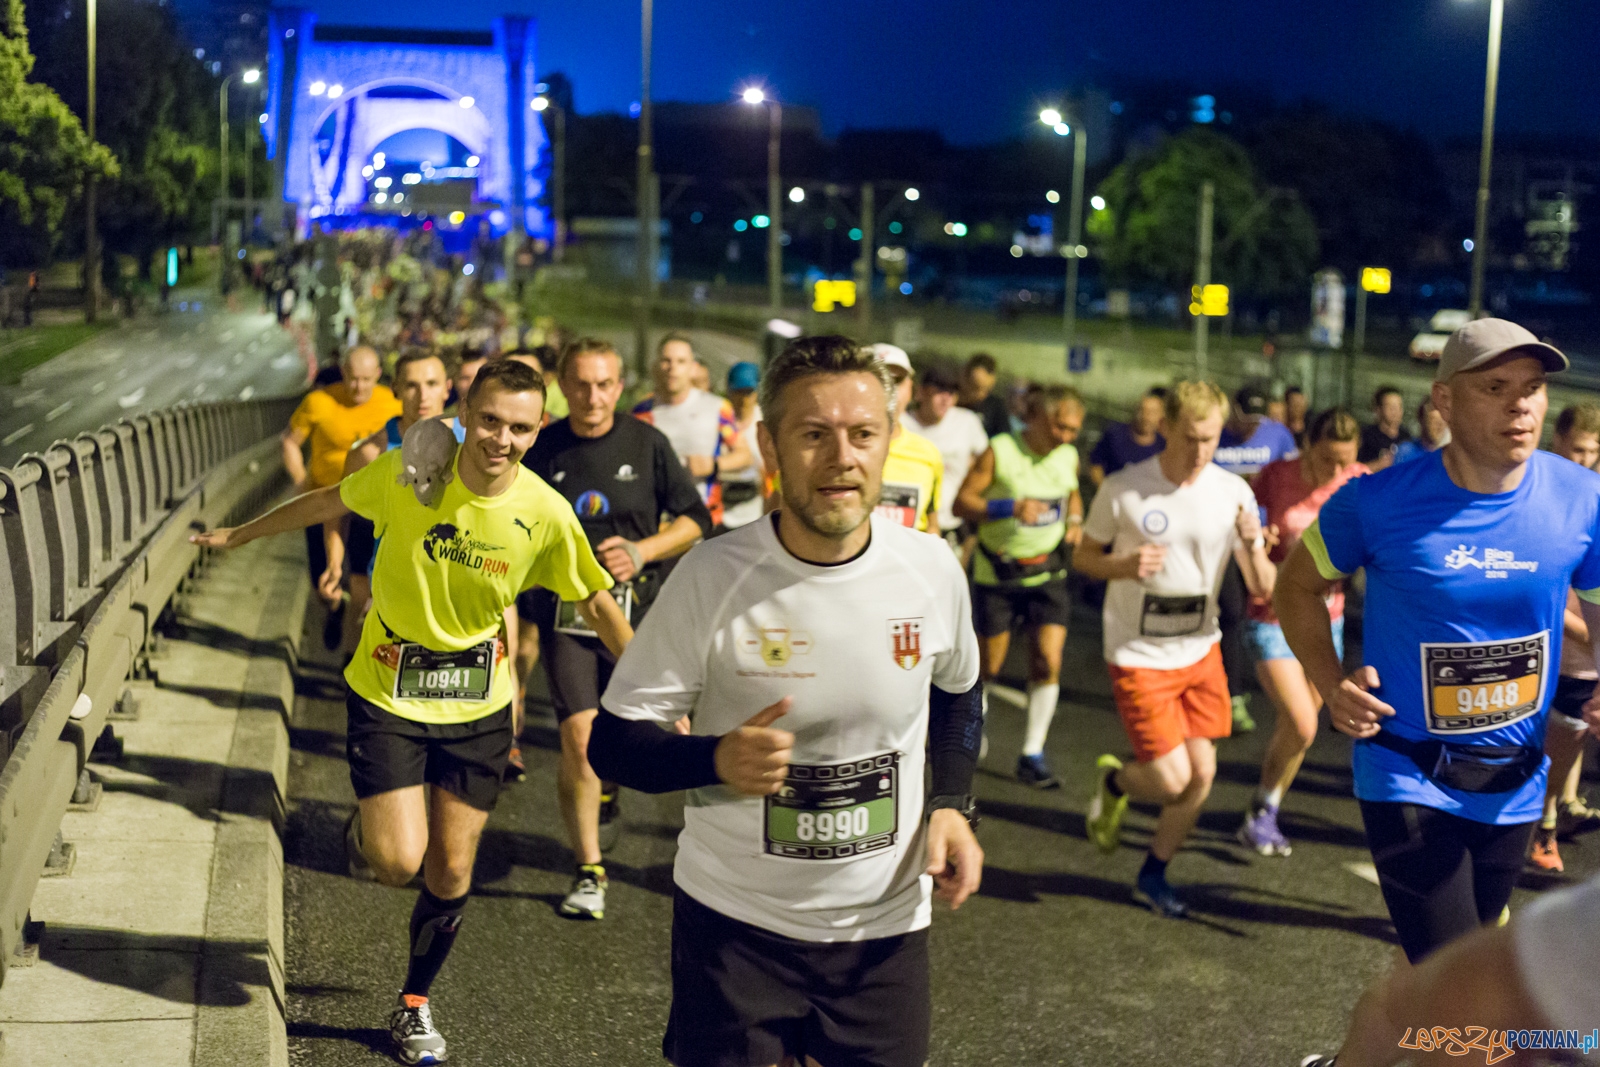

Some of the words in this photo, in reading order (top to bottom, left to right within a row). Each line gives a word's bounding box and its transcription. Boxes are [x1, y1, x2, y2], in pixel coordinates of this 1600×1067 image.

[439, 545, 483, 569] WORLD
[482, 558, 510, 575] RUN
[1485, 548, 1514, 562] Bieg
[418, 670, 470, 688] 10941
[1457, 682, 1520, 713] 9448
[796, 806, 869, 842] 8990
